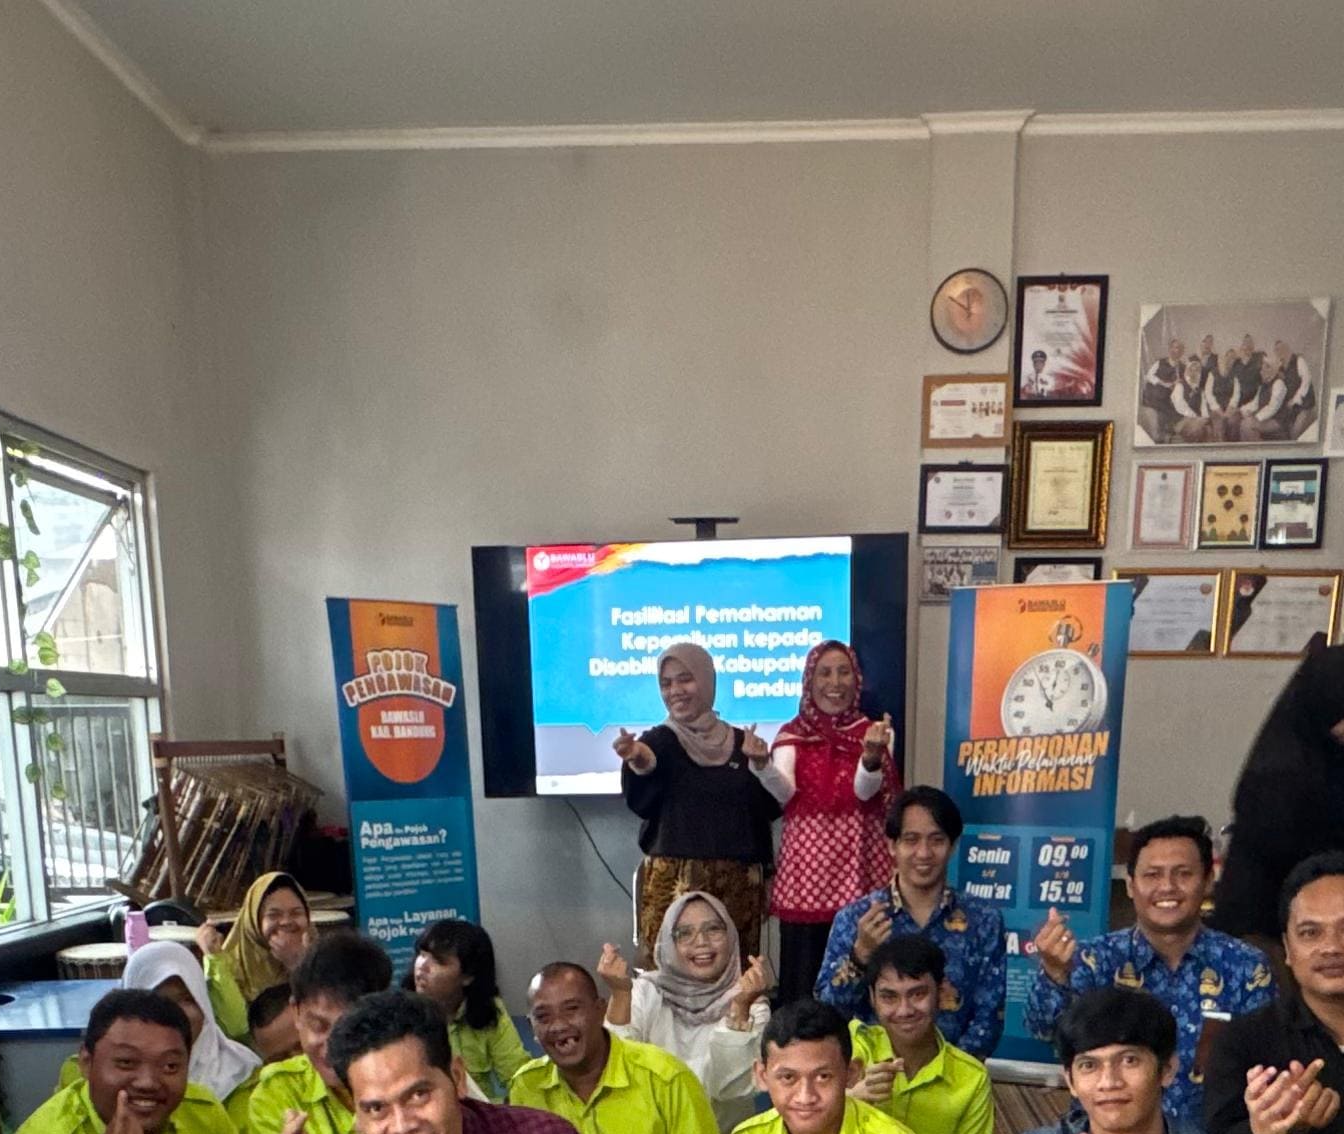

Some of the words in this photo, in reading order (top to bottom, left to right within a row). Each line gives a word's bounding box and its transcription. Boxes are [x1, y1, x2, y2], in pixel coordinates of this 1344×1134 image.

[611, 606, 690, 626] Fasilitasi
[696, 604, 823, 624] Pemahaman
[744, 628, 822, 651] kepada
[343, 672, 454, 706] PENGAWASAN
[957, 730, 1110, 767] PERMOHONAN
[972, 765, 1095, 798] INFORMASI
[360, 821, 394, 837] Apa
[360, 829, 447, 849] Pengawasan?
[968, 846, 1011, 864] Senin
[404, 908, 457, 924] Layanan
